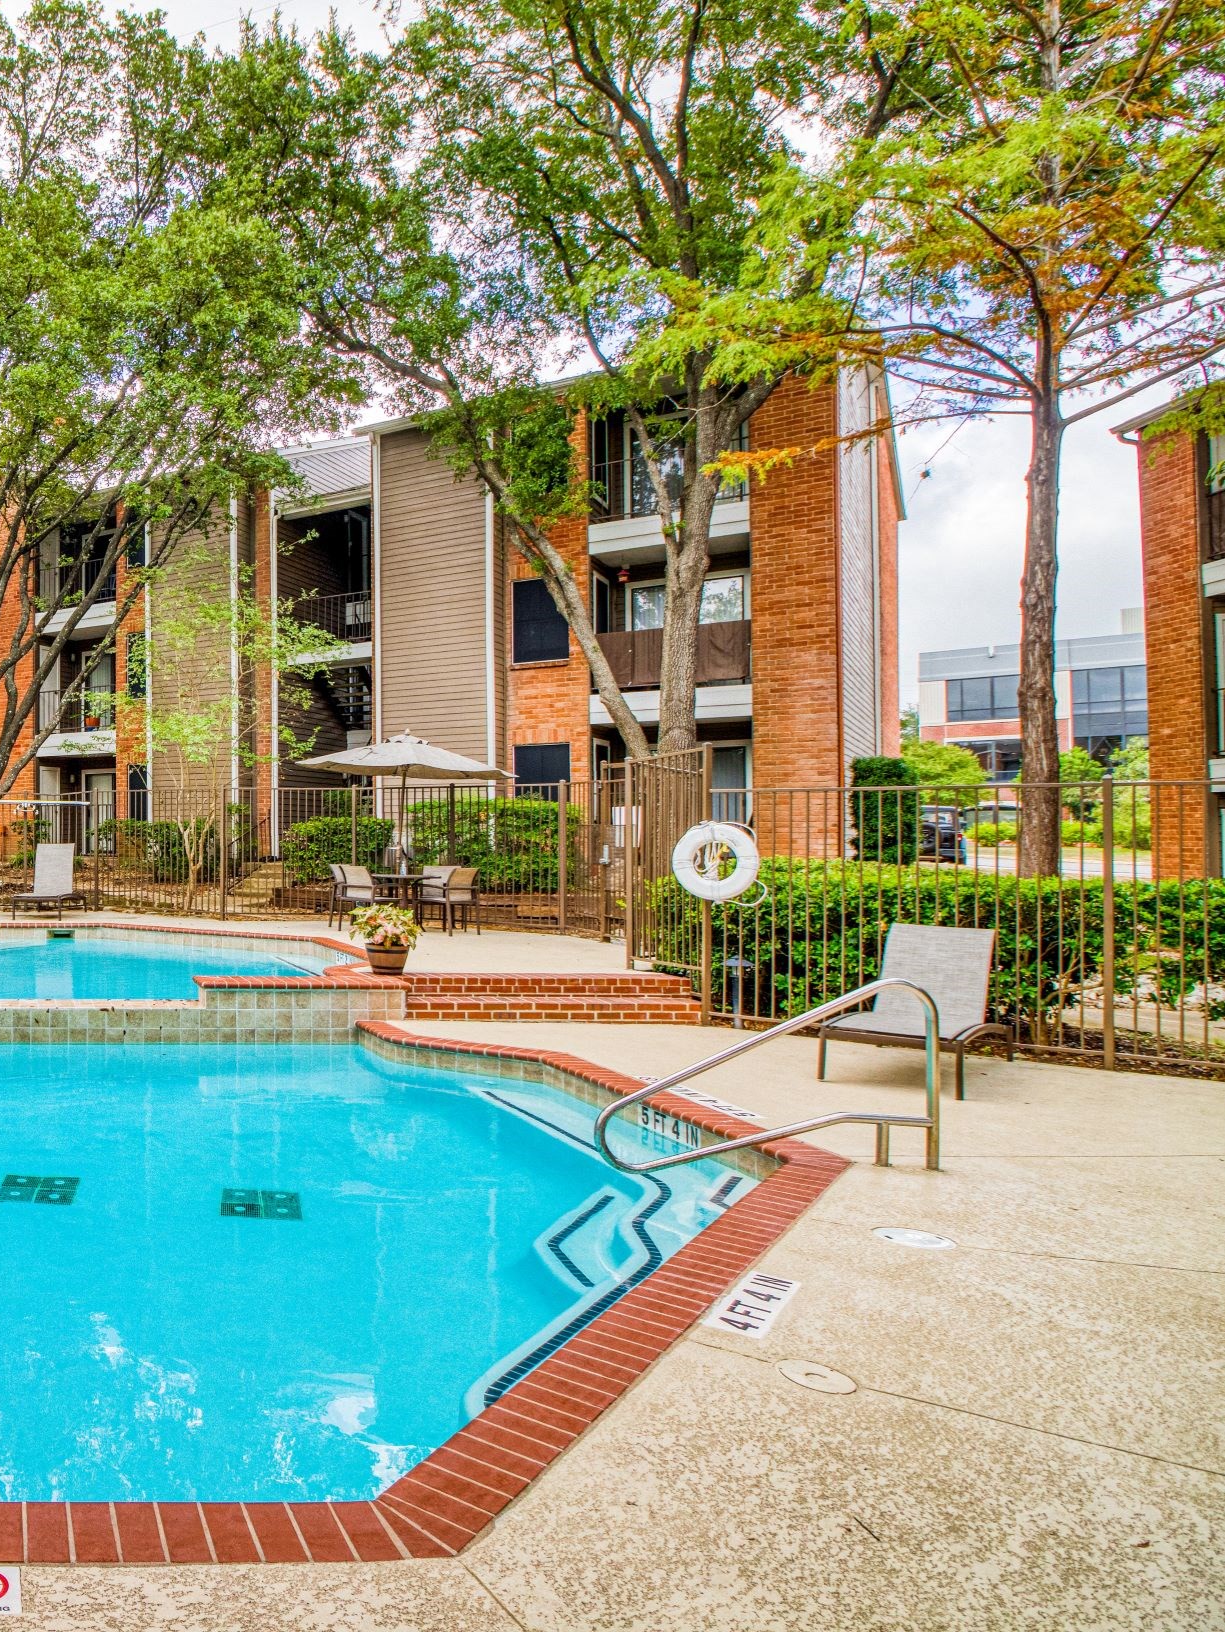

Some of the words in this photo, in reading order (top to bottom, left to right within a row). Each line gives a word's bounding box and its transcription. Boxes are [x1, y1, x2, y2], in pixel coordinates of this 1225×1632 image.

[641, 1105, 649, 1125] 5
[654, 1110, 666, 1133] FT
[672, 1119, 679, 1139] 4
[686, 1123, 698, 1148] IN
[750, 1274, 793, 1292] IN
[742, 1288, 782, 1302] 4
[726, 1299, 772, 1322] FT
[718, 1316, 760, 1331] 4
